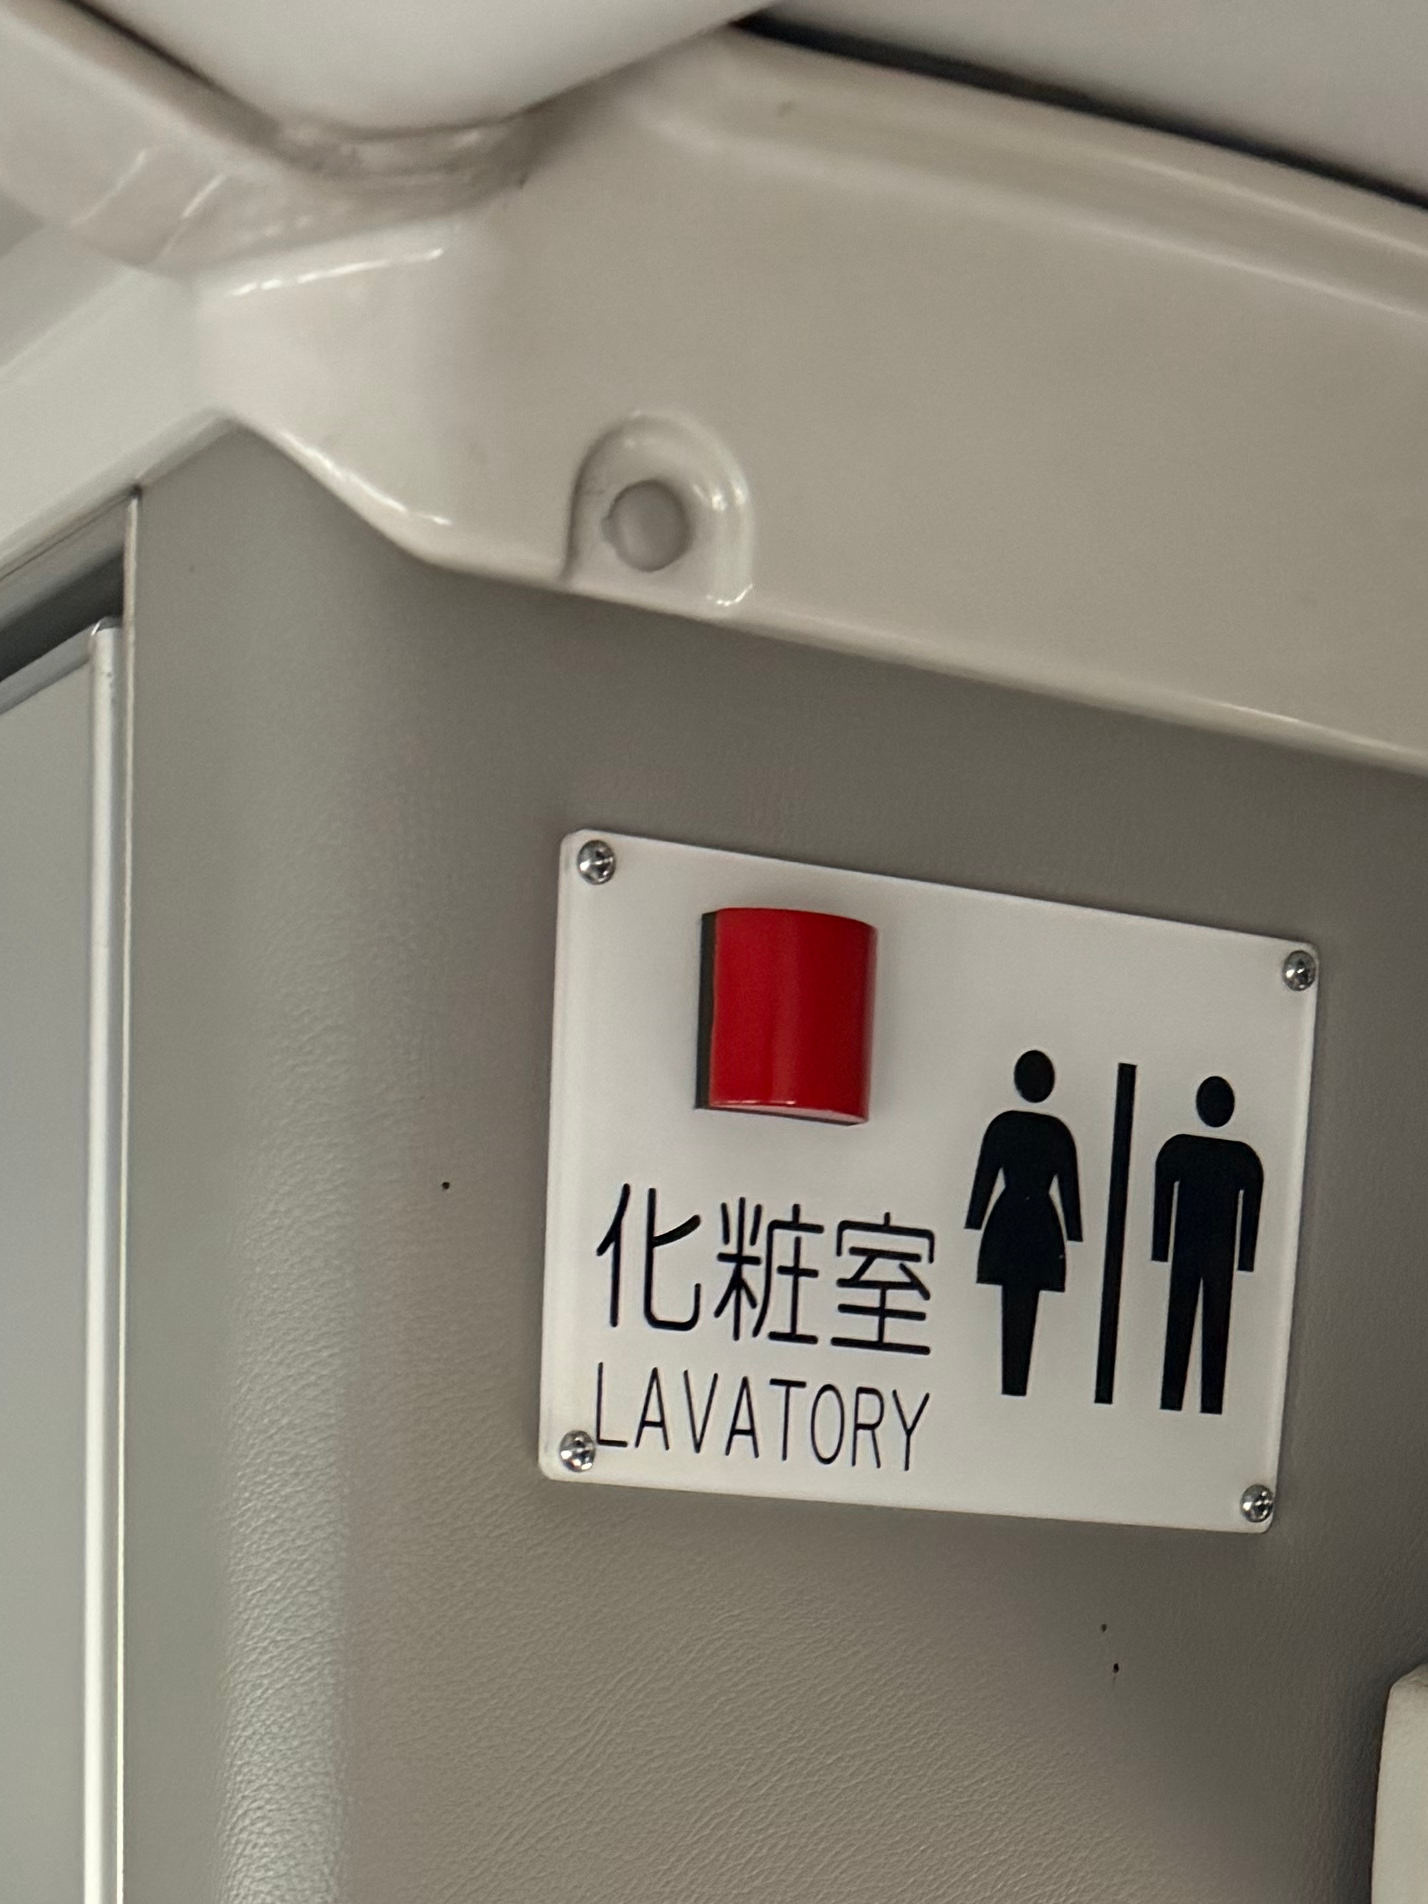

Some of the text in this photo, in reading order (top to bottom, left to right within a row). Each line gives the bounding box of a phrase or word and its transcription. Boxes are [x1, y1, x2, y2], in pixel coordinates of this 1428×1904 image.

[596, 1183, 934, 1356] 化粧室
[595, 1361, 930, 1472] LAVATORY
